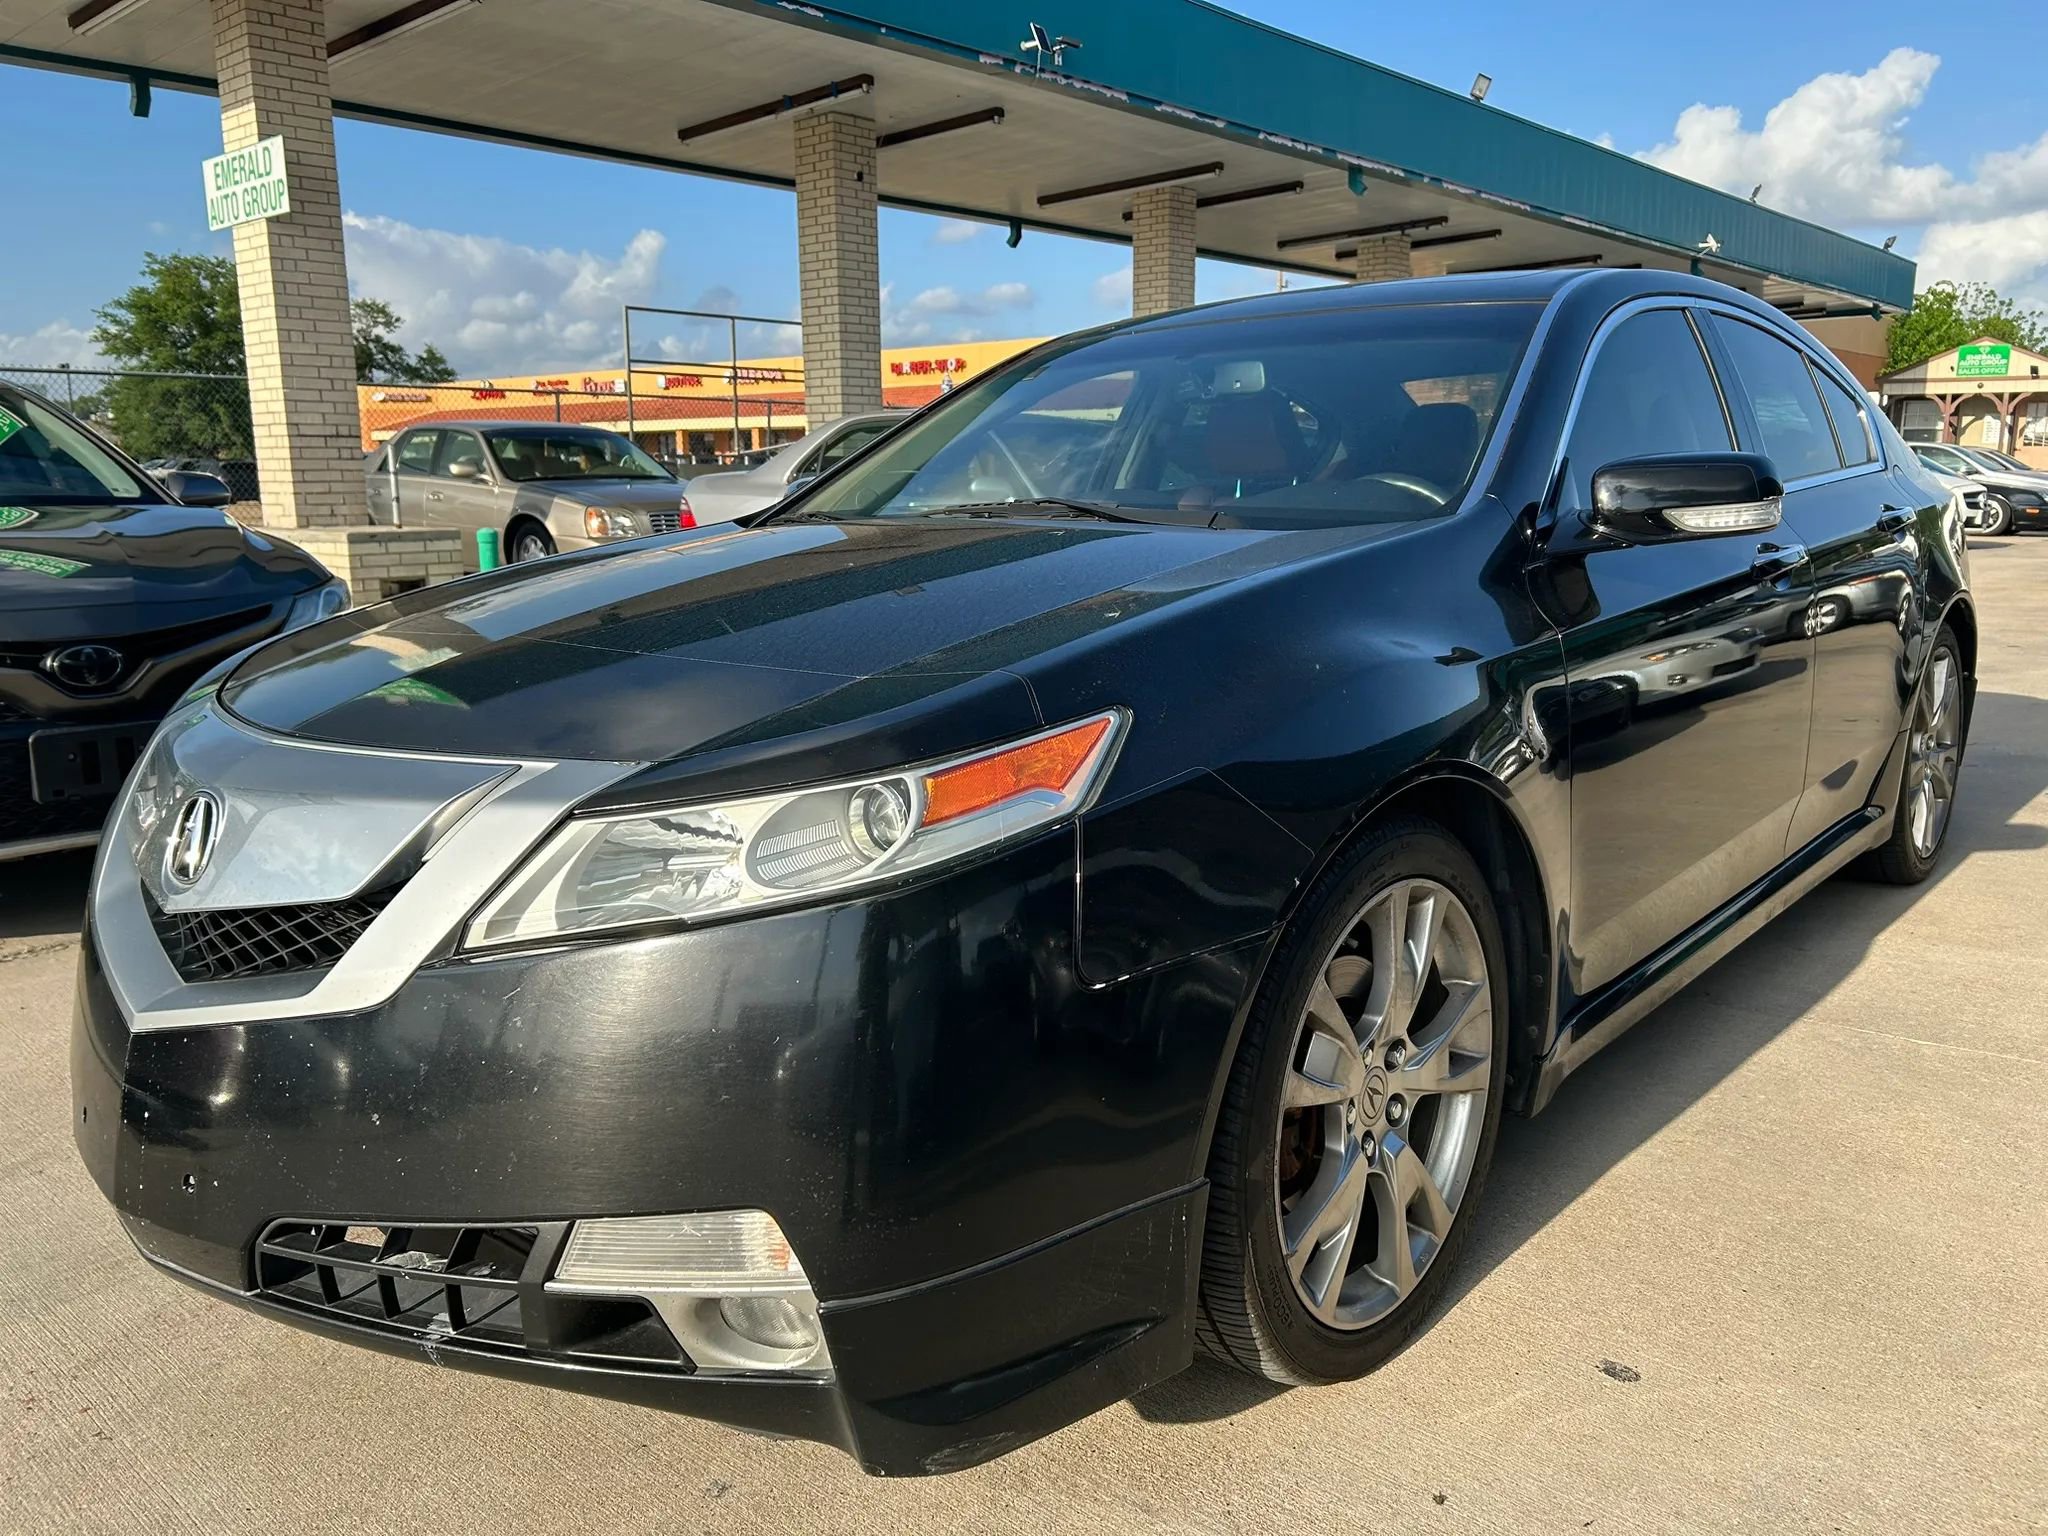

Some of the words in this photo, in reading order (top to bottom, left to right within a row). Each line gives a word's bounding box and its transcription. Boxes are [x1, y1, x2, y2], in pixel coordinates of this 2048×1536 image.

[213, 146, 272, 191] EMERALD
[210, 190, 240, 227] AUTO
[242, 178, 285, 218] GROUP
